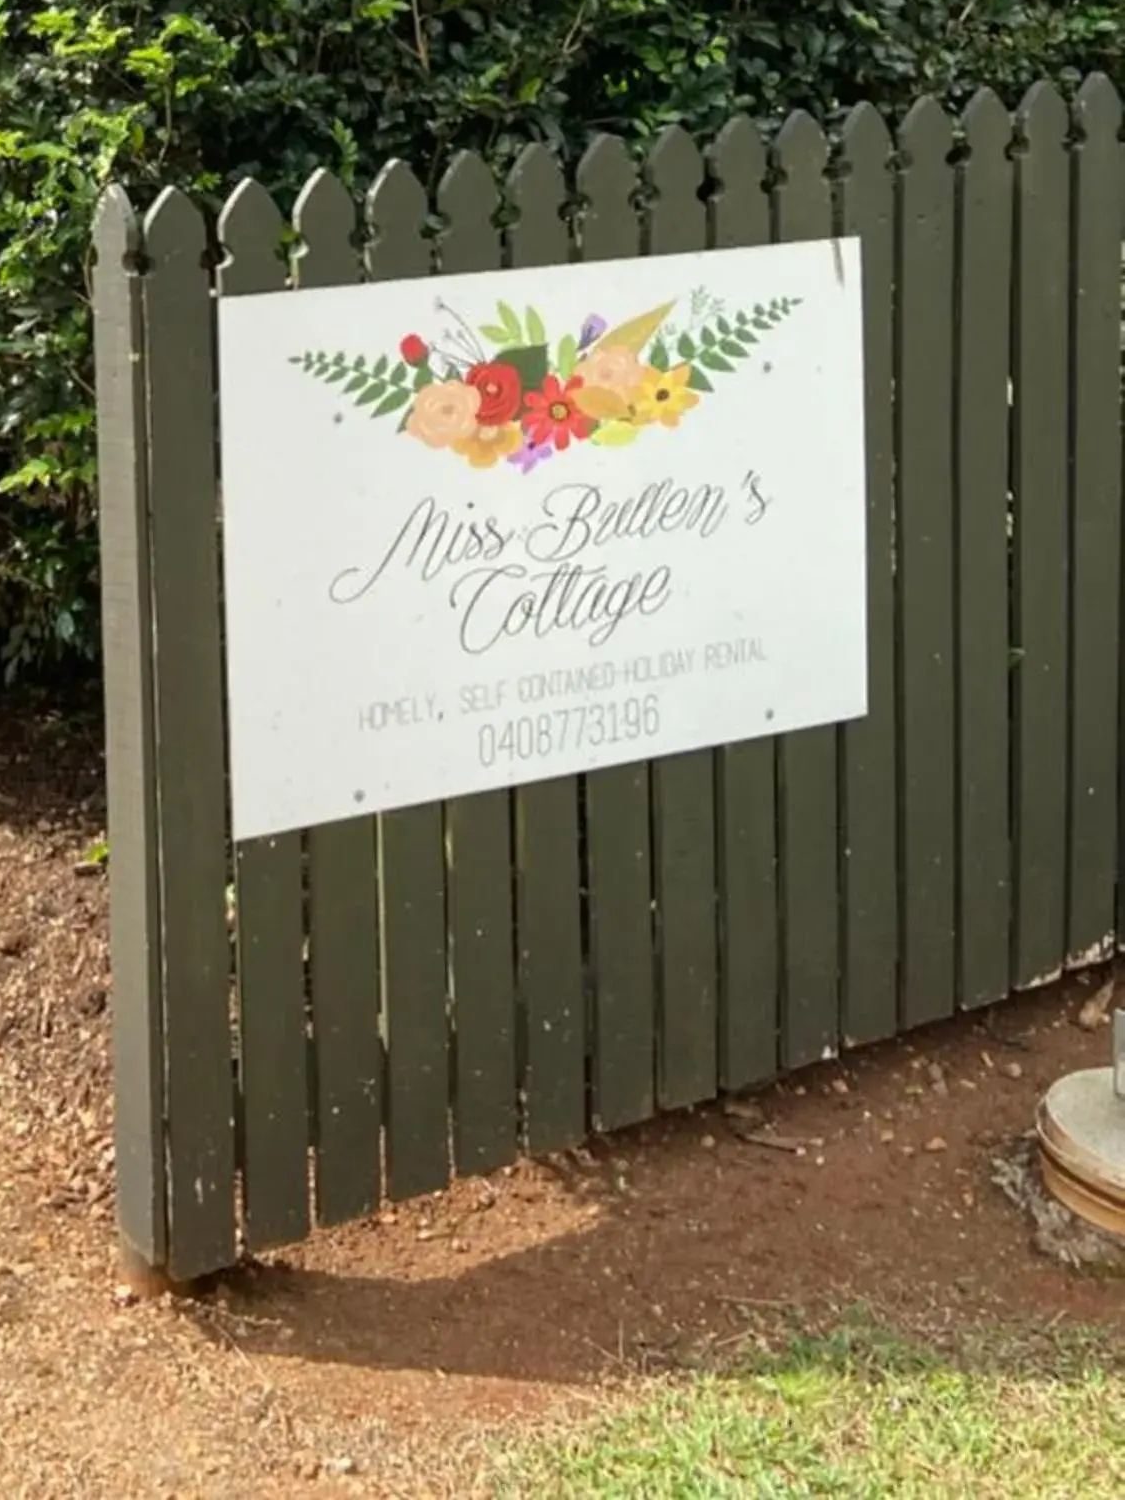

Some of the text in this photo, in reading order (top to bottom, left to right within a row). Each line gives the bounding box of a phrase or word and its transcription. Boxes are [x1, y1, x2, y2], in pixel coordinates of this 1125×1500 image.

[329, 469, 772, 604] Miss Bullen's
[449, 562, 673, 655] Cottage
[358, 689, 443, 732] HOMELY,
[459, 678, 507, 715] SELF
[704, 635, 768, 671] RENTAL
[478, 693, 660, 768] 0408773196
